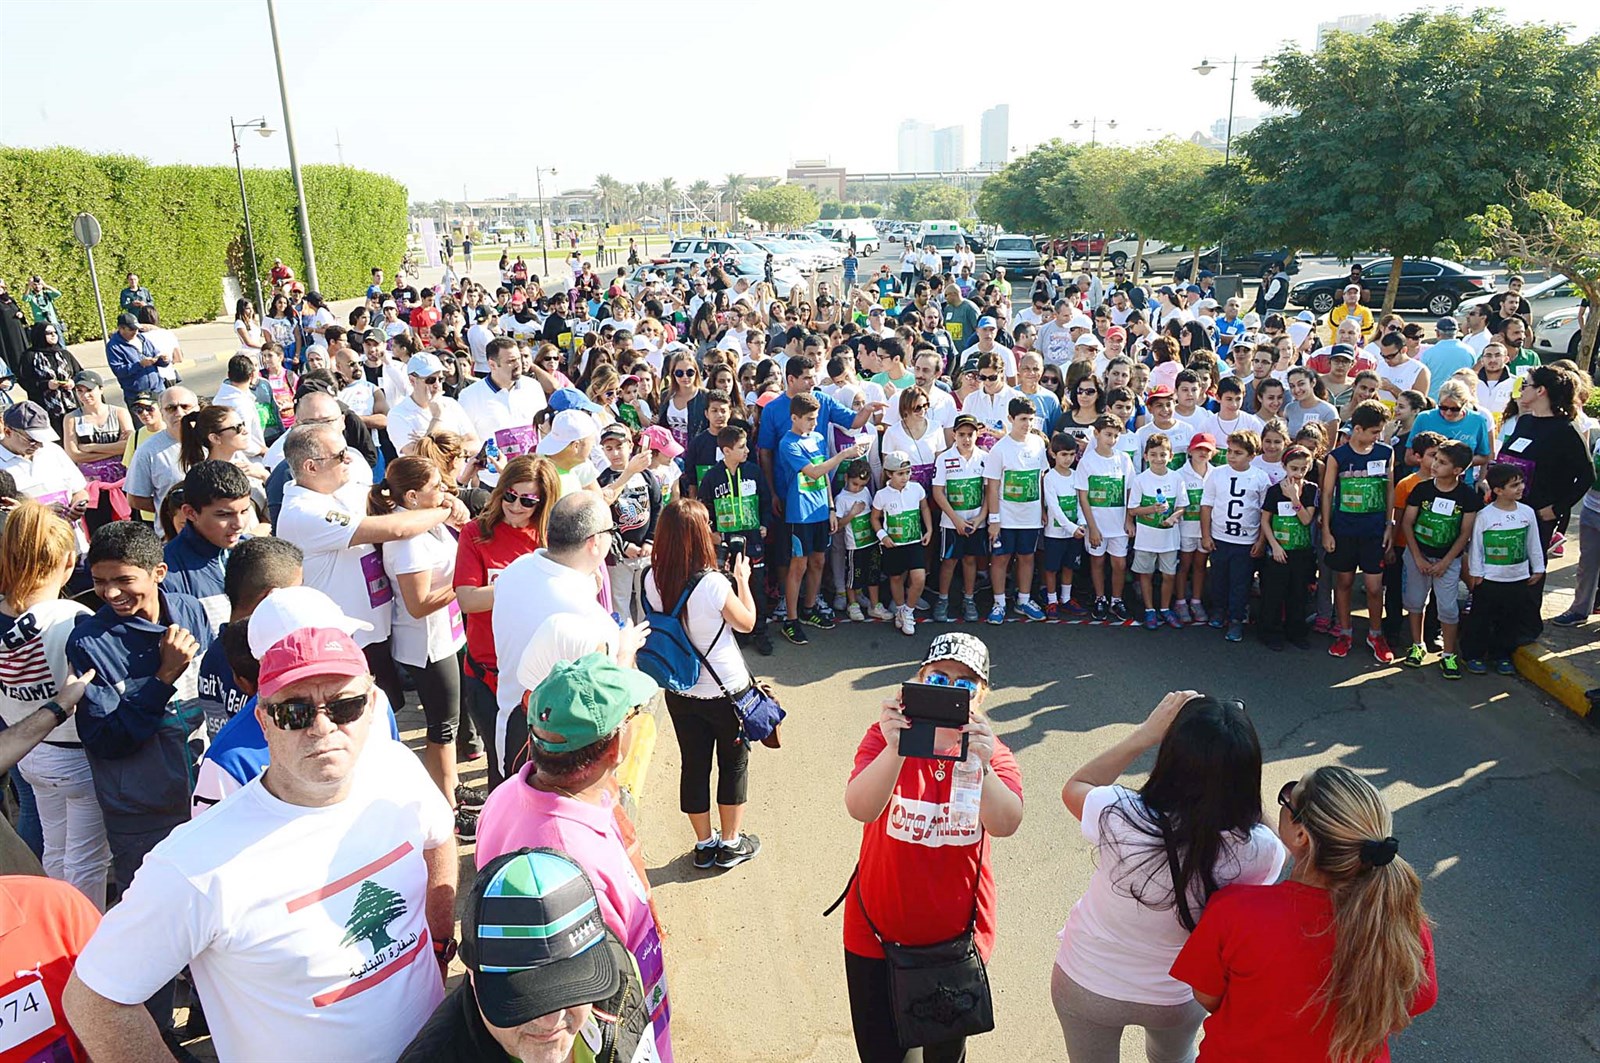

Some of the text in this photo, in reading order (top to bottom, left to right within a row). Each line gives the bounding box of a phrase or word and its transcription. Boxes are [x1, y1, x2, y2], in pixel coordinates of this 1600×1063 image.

[743, 482, 752, 490] 26
[1438, 502, 1448, 510] 61
[1506, 514, 1516, 523] 58
[0, 612, 42, 649] ER
[928, 643, 948, 660] LAS
[349, 932, 418, 979] السفارة اللبنانية
